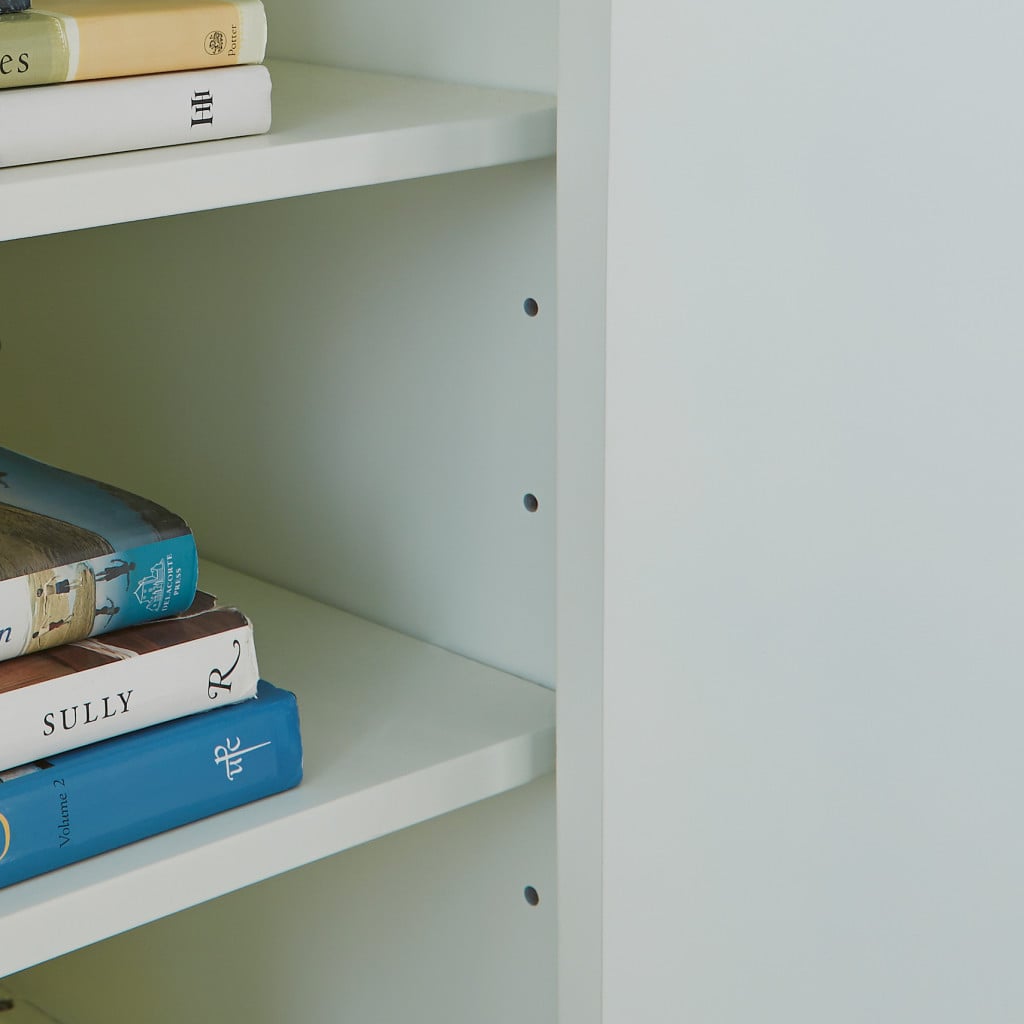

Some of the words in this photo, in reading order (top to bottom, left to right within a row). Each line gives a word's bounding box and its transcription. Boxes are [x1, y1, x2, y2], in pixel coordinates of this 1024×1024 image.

[228, 24, 237, 56] Potter
[162, 553, 173, 611] DELACORTE
[174, 568, 182, 596] PRESS
[43, 690, 133, 736] SULLY
[54, 778, 65, 788] 2
[59, 793, 71, 848] Volume
